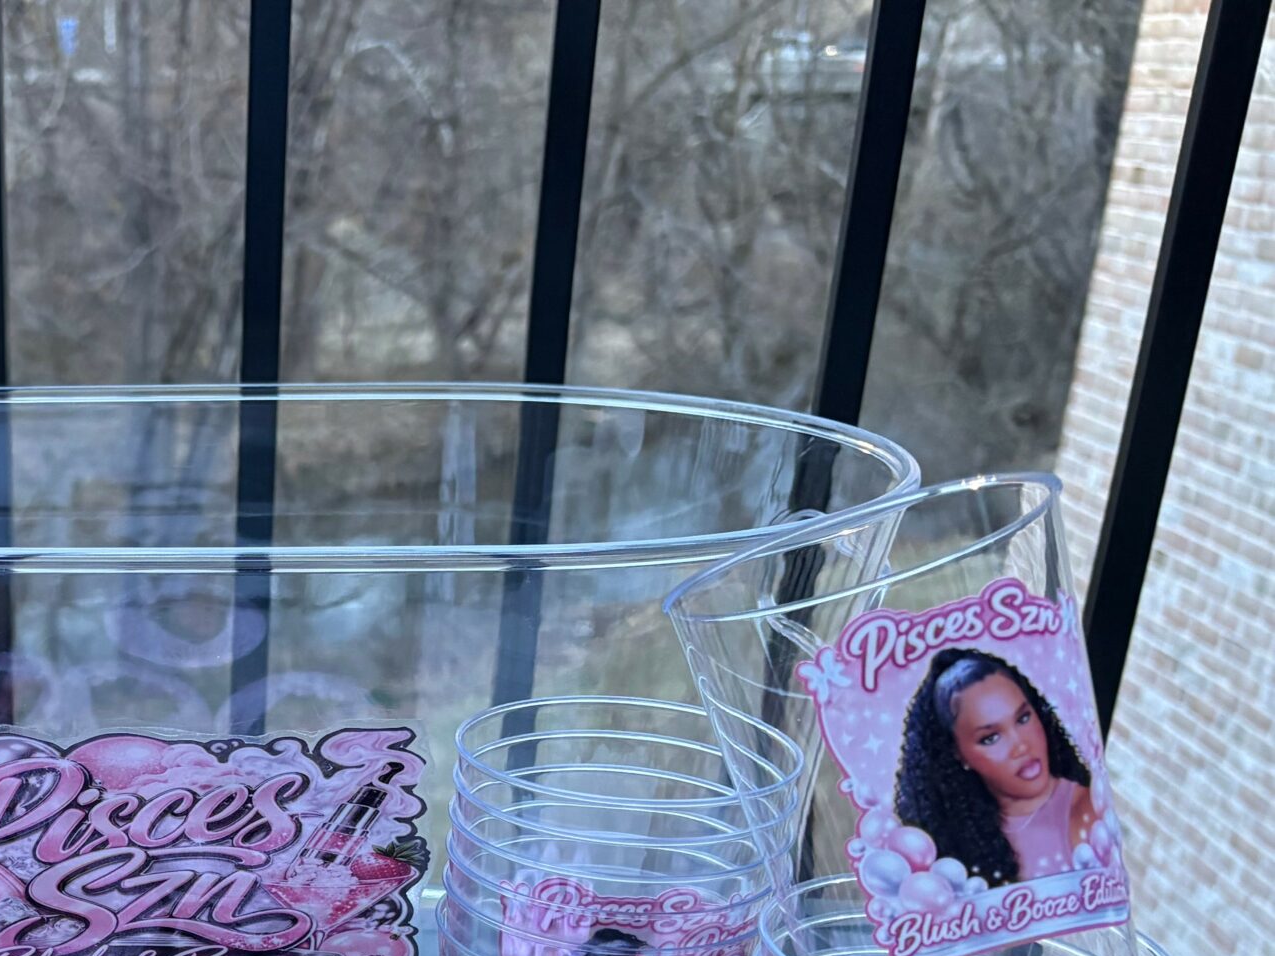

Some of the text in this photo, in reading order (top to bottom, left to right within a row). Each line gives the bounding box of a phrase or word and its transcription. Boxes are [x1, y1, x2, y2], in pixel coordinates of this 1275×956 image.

[848, 585, 1062, 692] Pisces Szn
[986, 908, 1004, 931] &
[1004, 889, 1080, 932] Booze
[1081, 873, 1126, 911] Edit
